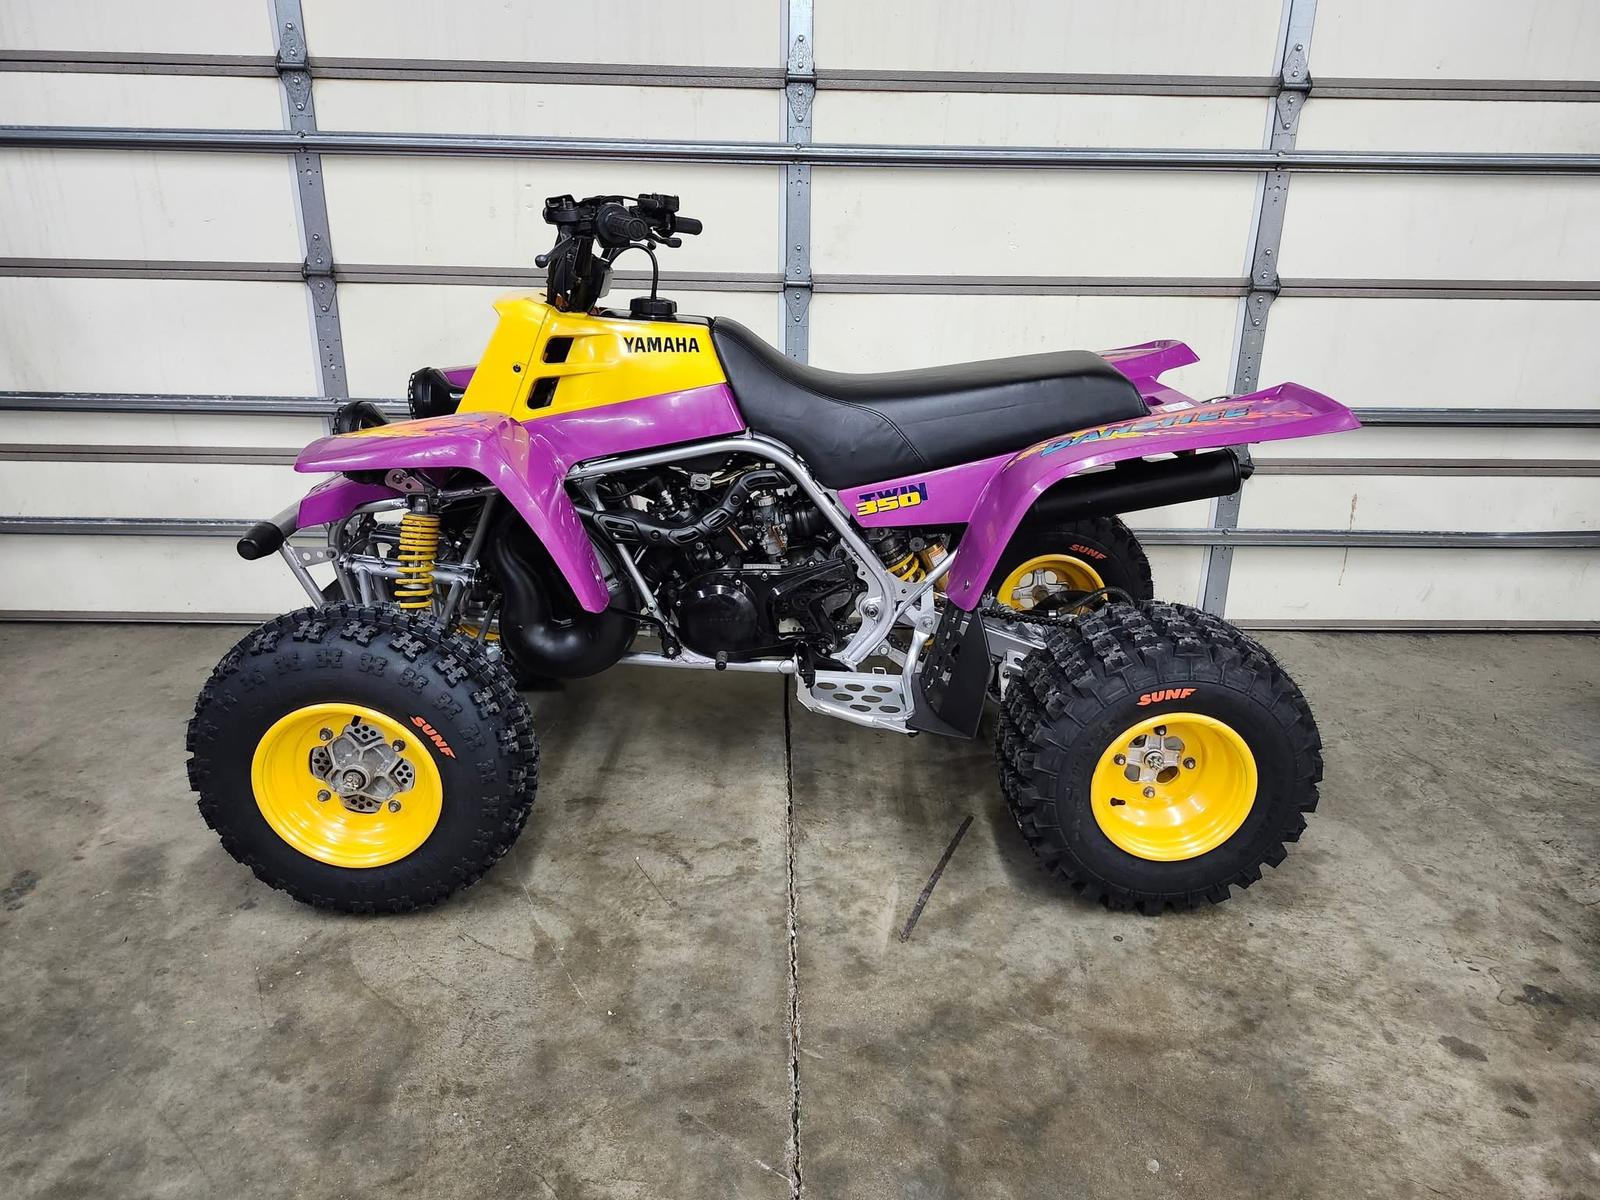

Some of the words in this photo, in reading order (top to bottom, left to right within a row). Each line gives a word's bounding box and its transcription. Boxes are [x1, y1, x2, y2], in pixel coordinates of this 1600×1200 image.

[624, 337, 700, 353] YAMAHA
[856, 491, 922, 516] 350
[1069, 544, 1107, 560] SUNF
[1136, 688, 1198, 706] SUNF
[410, 716, 456, 759] SUNF
